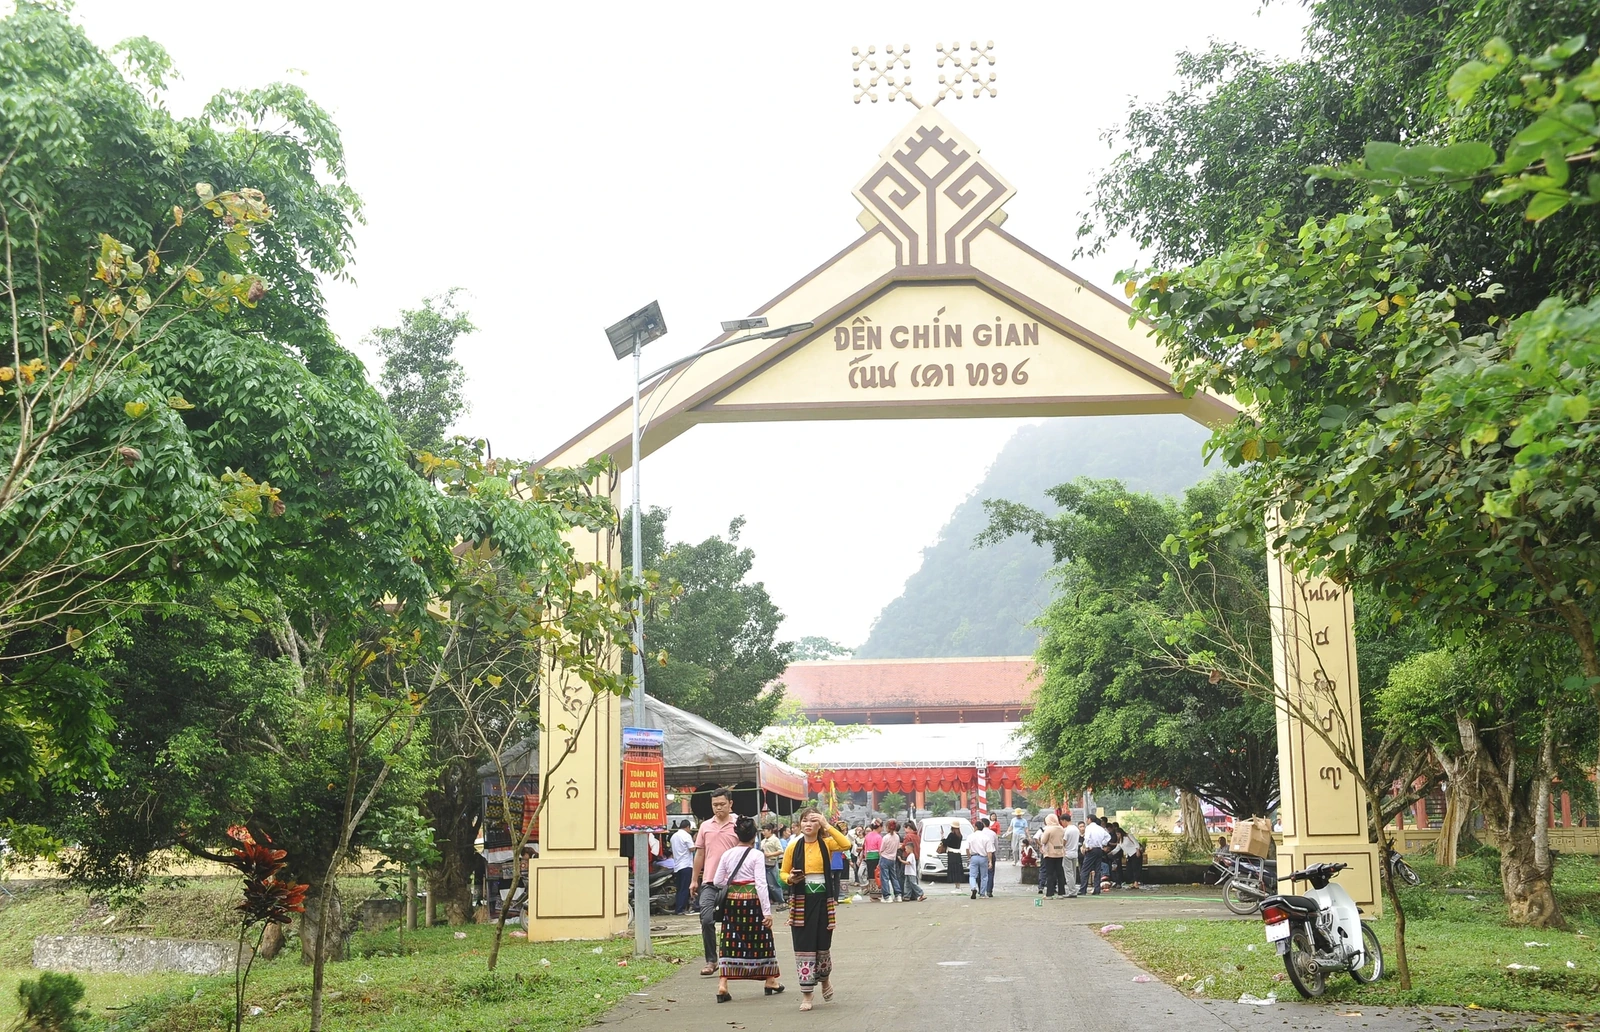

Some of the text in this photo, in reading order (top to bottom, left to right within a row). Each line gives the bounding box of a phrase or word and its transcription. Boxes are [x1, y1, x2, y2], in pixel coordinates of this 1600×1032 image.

[834, 316, 882, 351] ĐỀN
[630, 769, 645, 778] TOÀN
[629, 790, 641, 799] XÂY
[641, 800, 659, 809] SỐNG
